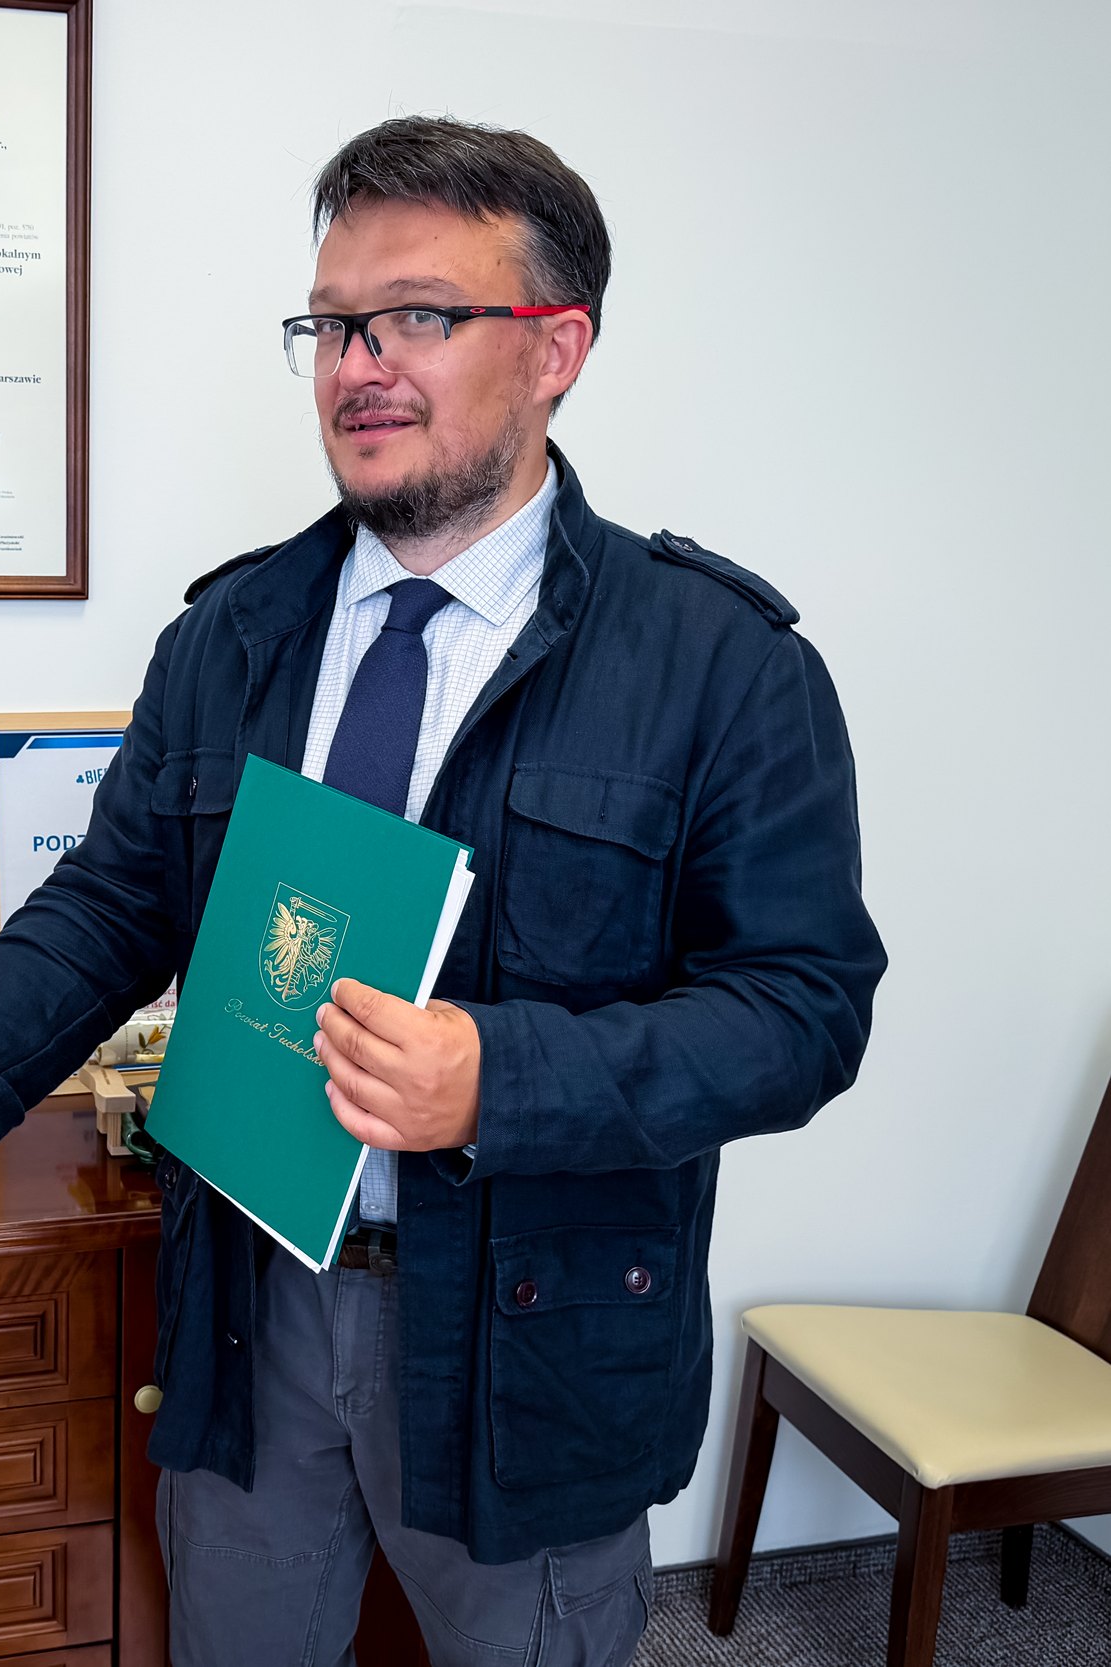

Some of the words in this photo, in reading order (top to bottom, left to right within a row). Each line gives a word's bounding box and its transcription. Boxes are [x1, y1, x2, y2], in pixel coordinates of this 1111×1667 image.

[84, 768, 108, 784] BIE
[33, 834, 86, 852] POD
[224, 998, 268, 1032] Powiat
